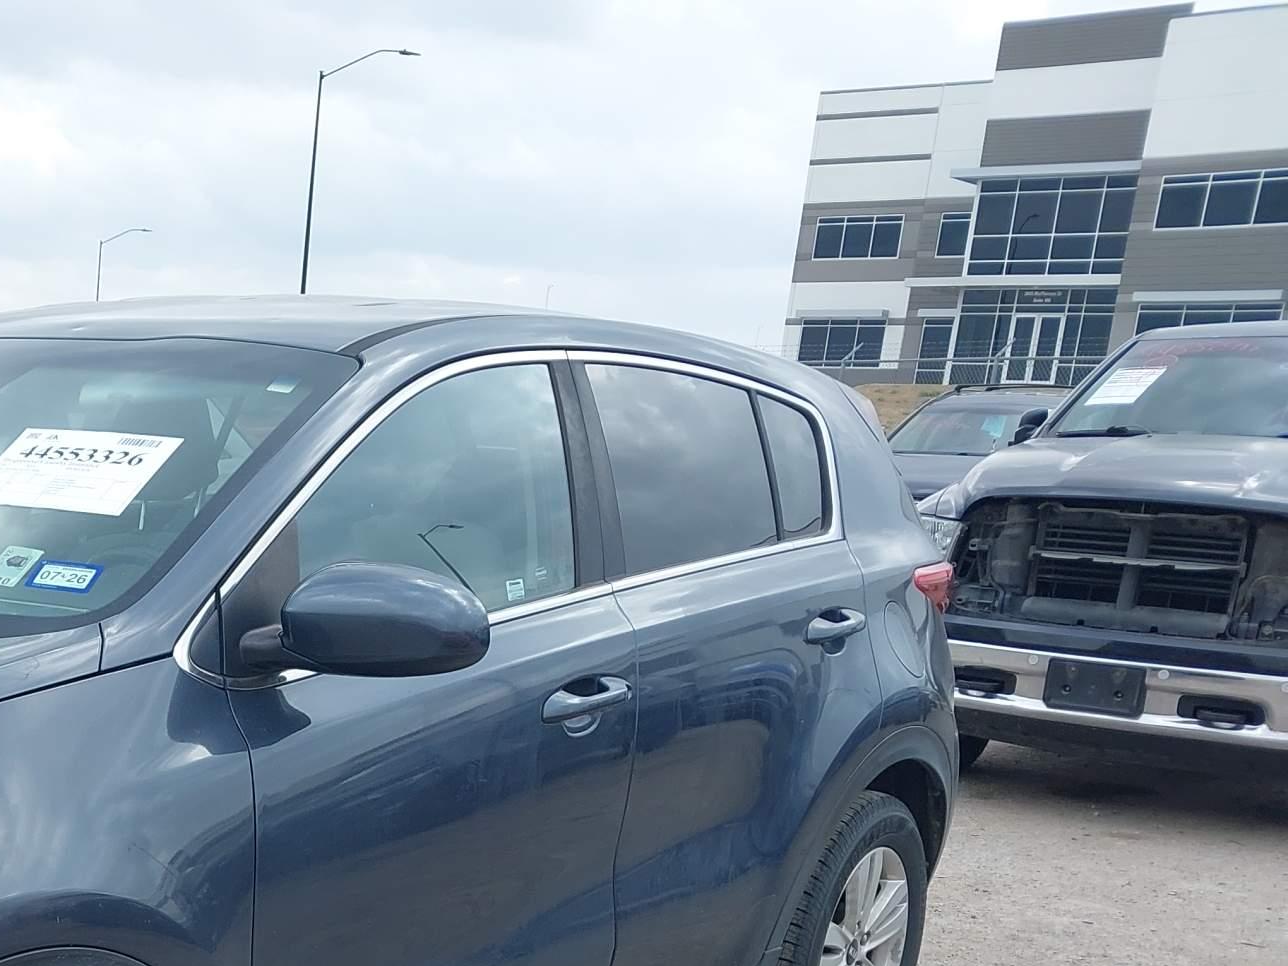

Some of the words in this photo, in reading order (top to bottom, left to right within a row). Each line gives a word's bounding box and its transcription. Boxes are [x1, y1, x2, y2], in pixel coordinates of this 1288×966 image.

[19, 445, 148, 467] 44553326
[40, 570, 61, 580] 07
[66, 573, 88, 584] 26
